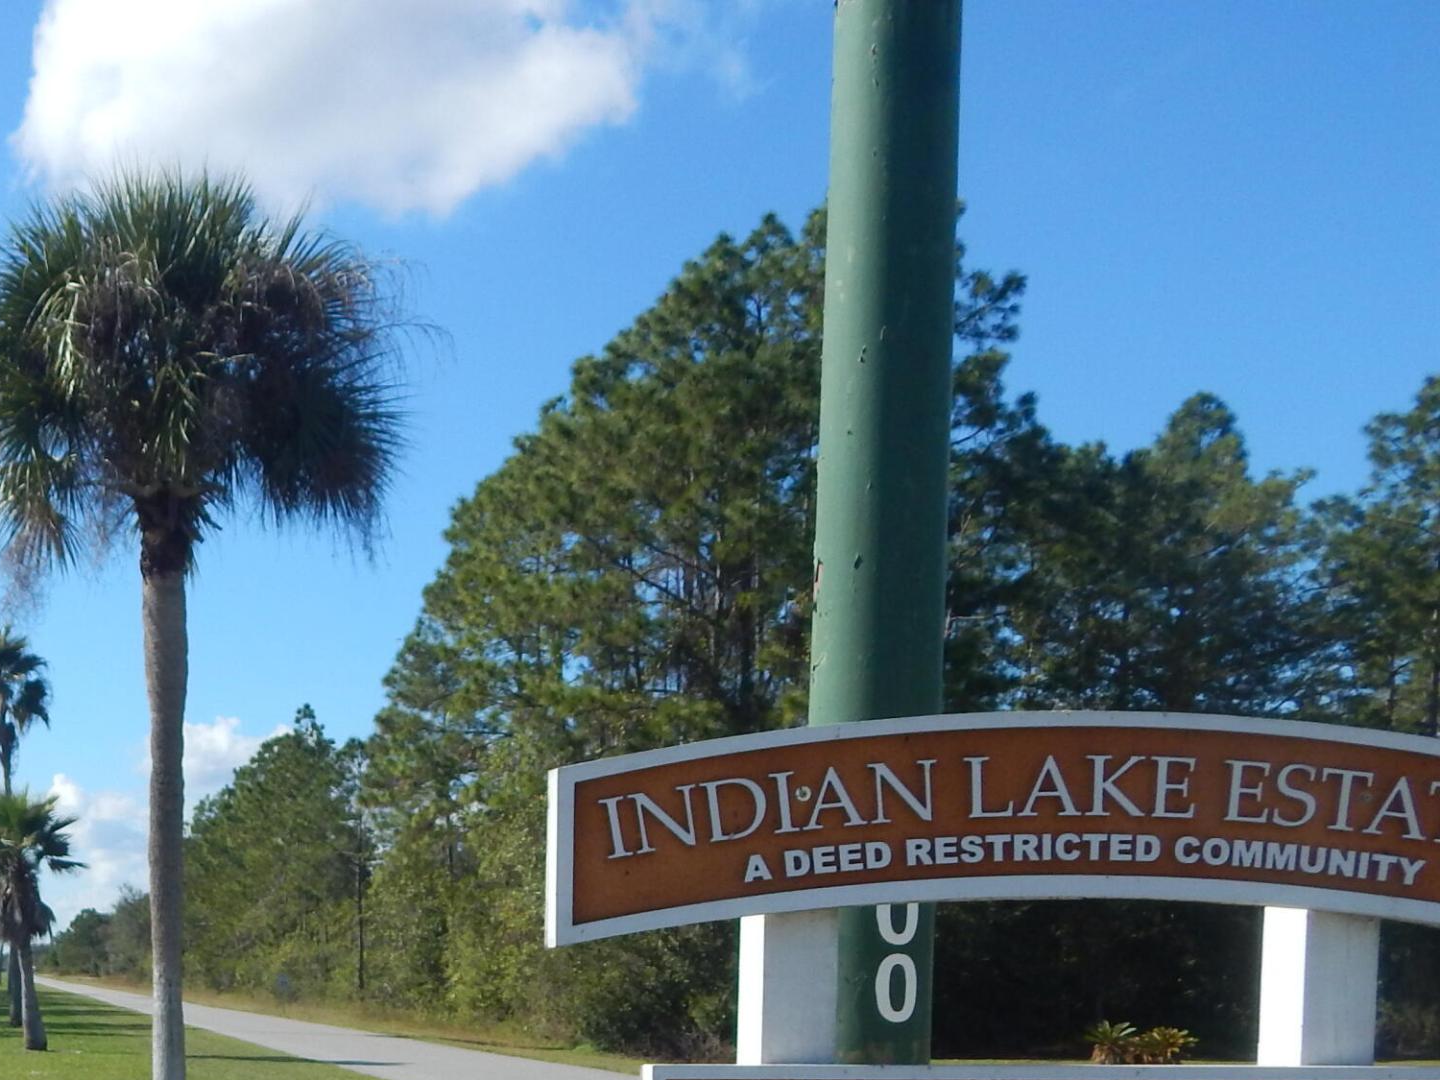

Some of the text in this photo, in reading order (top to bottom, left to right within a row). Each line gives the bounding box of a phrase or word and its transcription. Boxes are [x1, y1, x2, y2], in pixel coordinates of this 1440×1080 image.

[598, 755, 1440, 858] INDIAN LAKE ESTA
[744, 833, 1426, 886] A DEED RESTRICTED COMMUNITY
